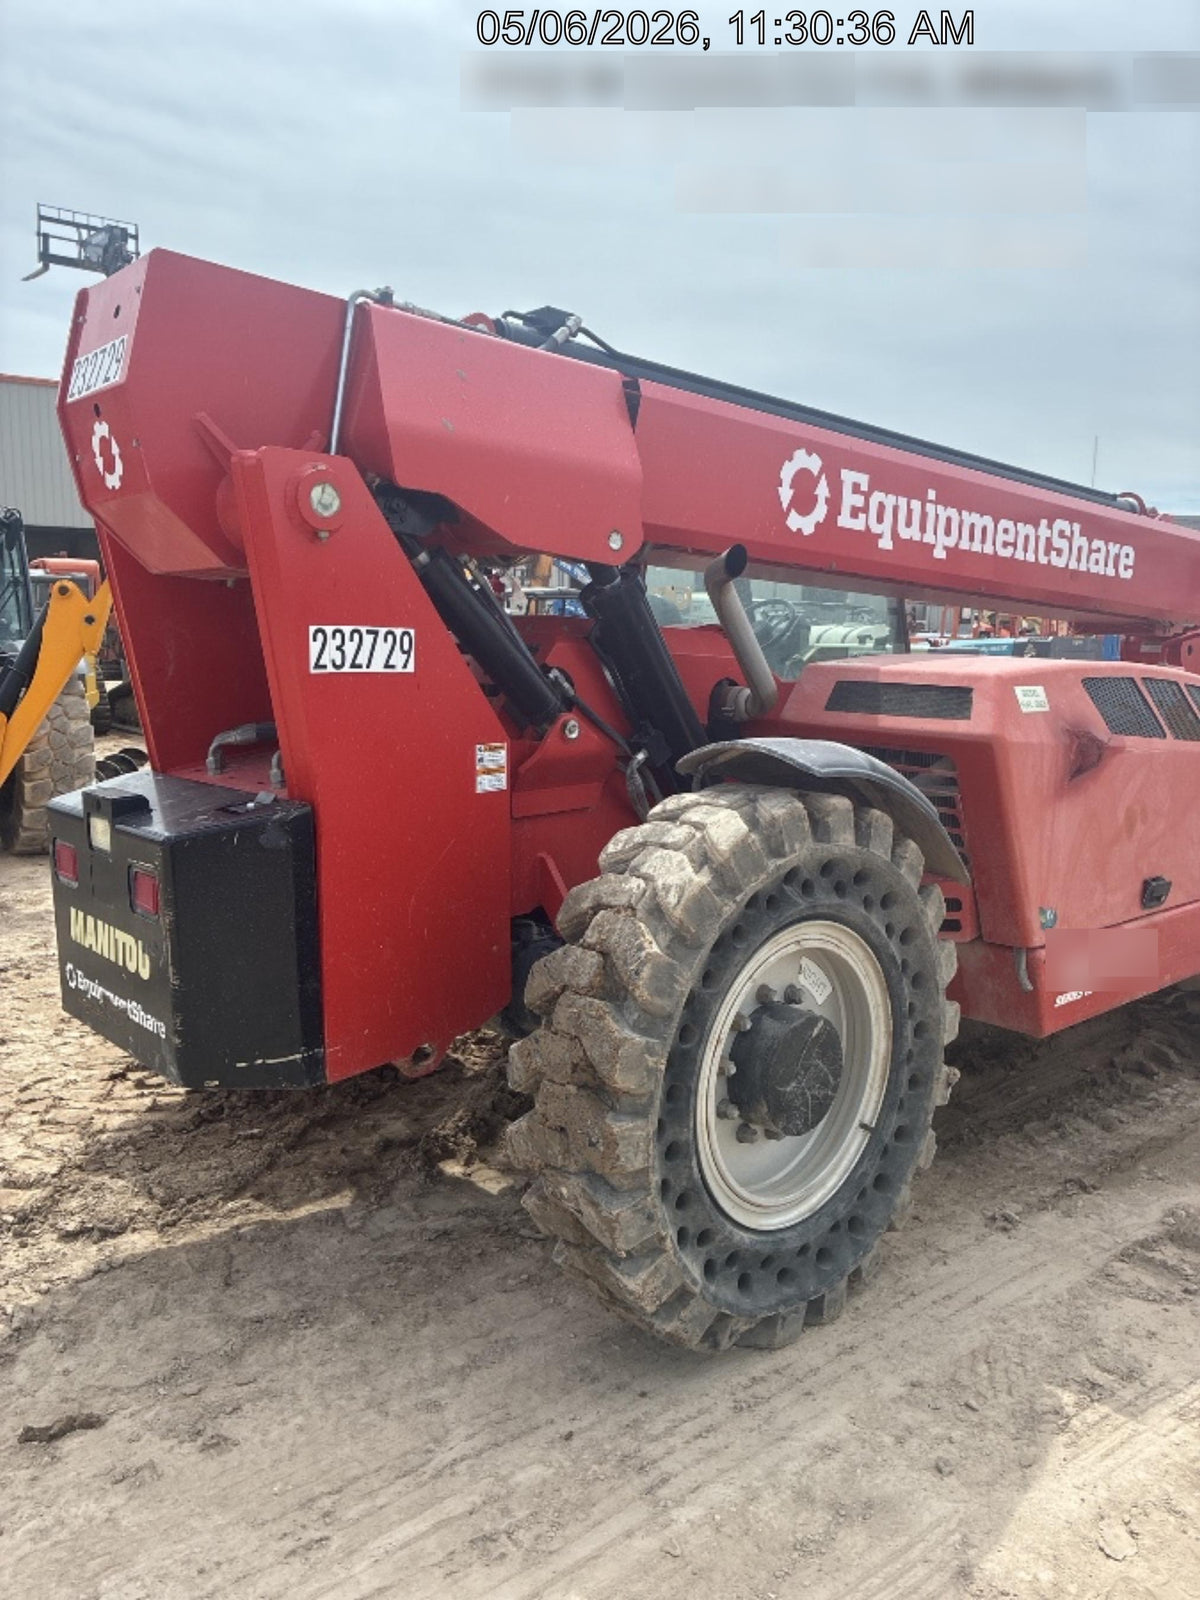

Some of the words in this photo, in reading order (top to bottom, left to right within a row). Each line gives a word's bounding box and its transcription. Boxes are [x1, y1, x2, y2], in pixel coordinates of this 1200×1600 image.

[69, 337, 125, 399] 232729
[837, 468, 1135, 579] EquipmentShare
[312, 627, 413, 670] 232729
[76, 969, 166, 1039] EquientShare
